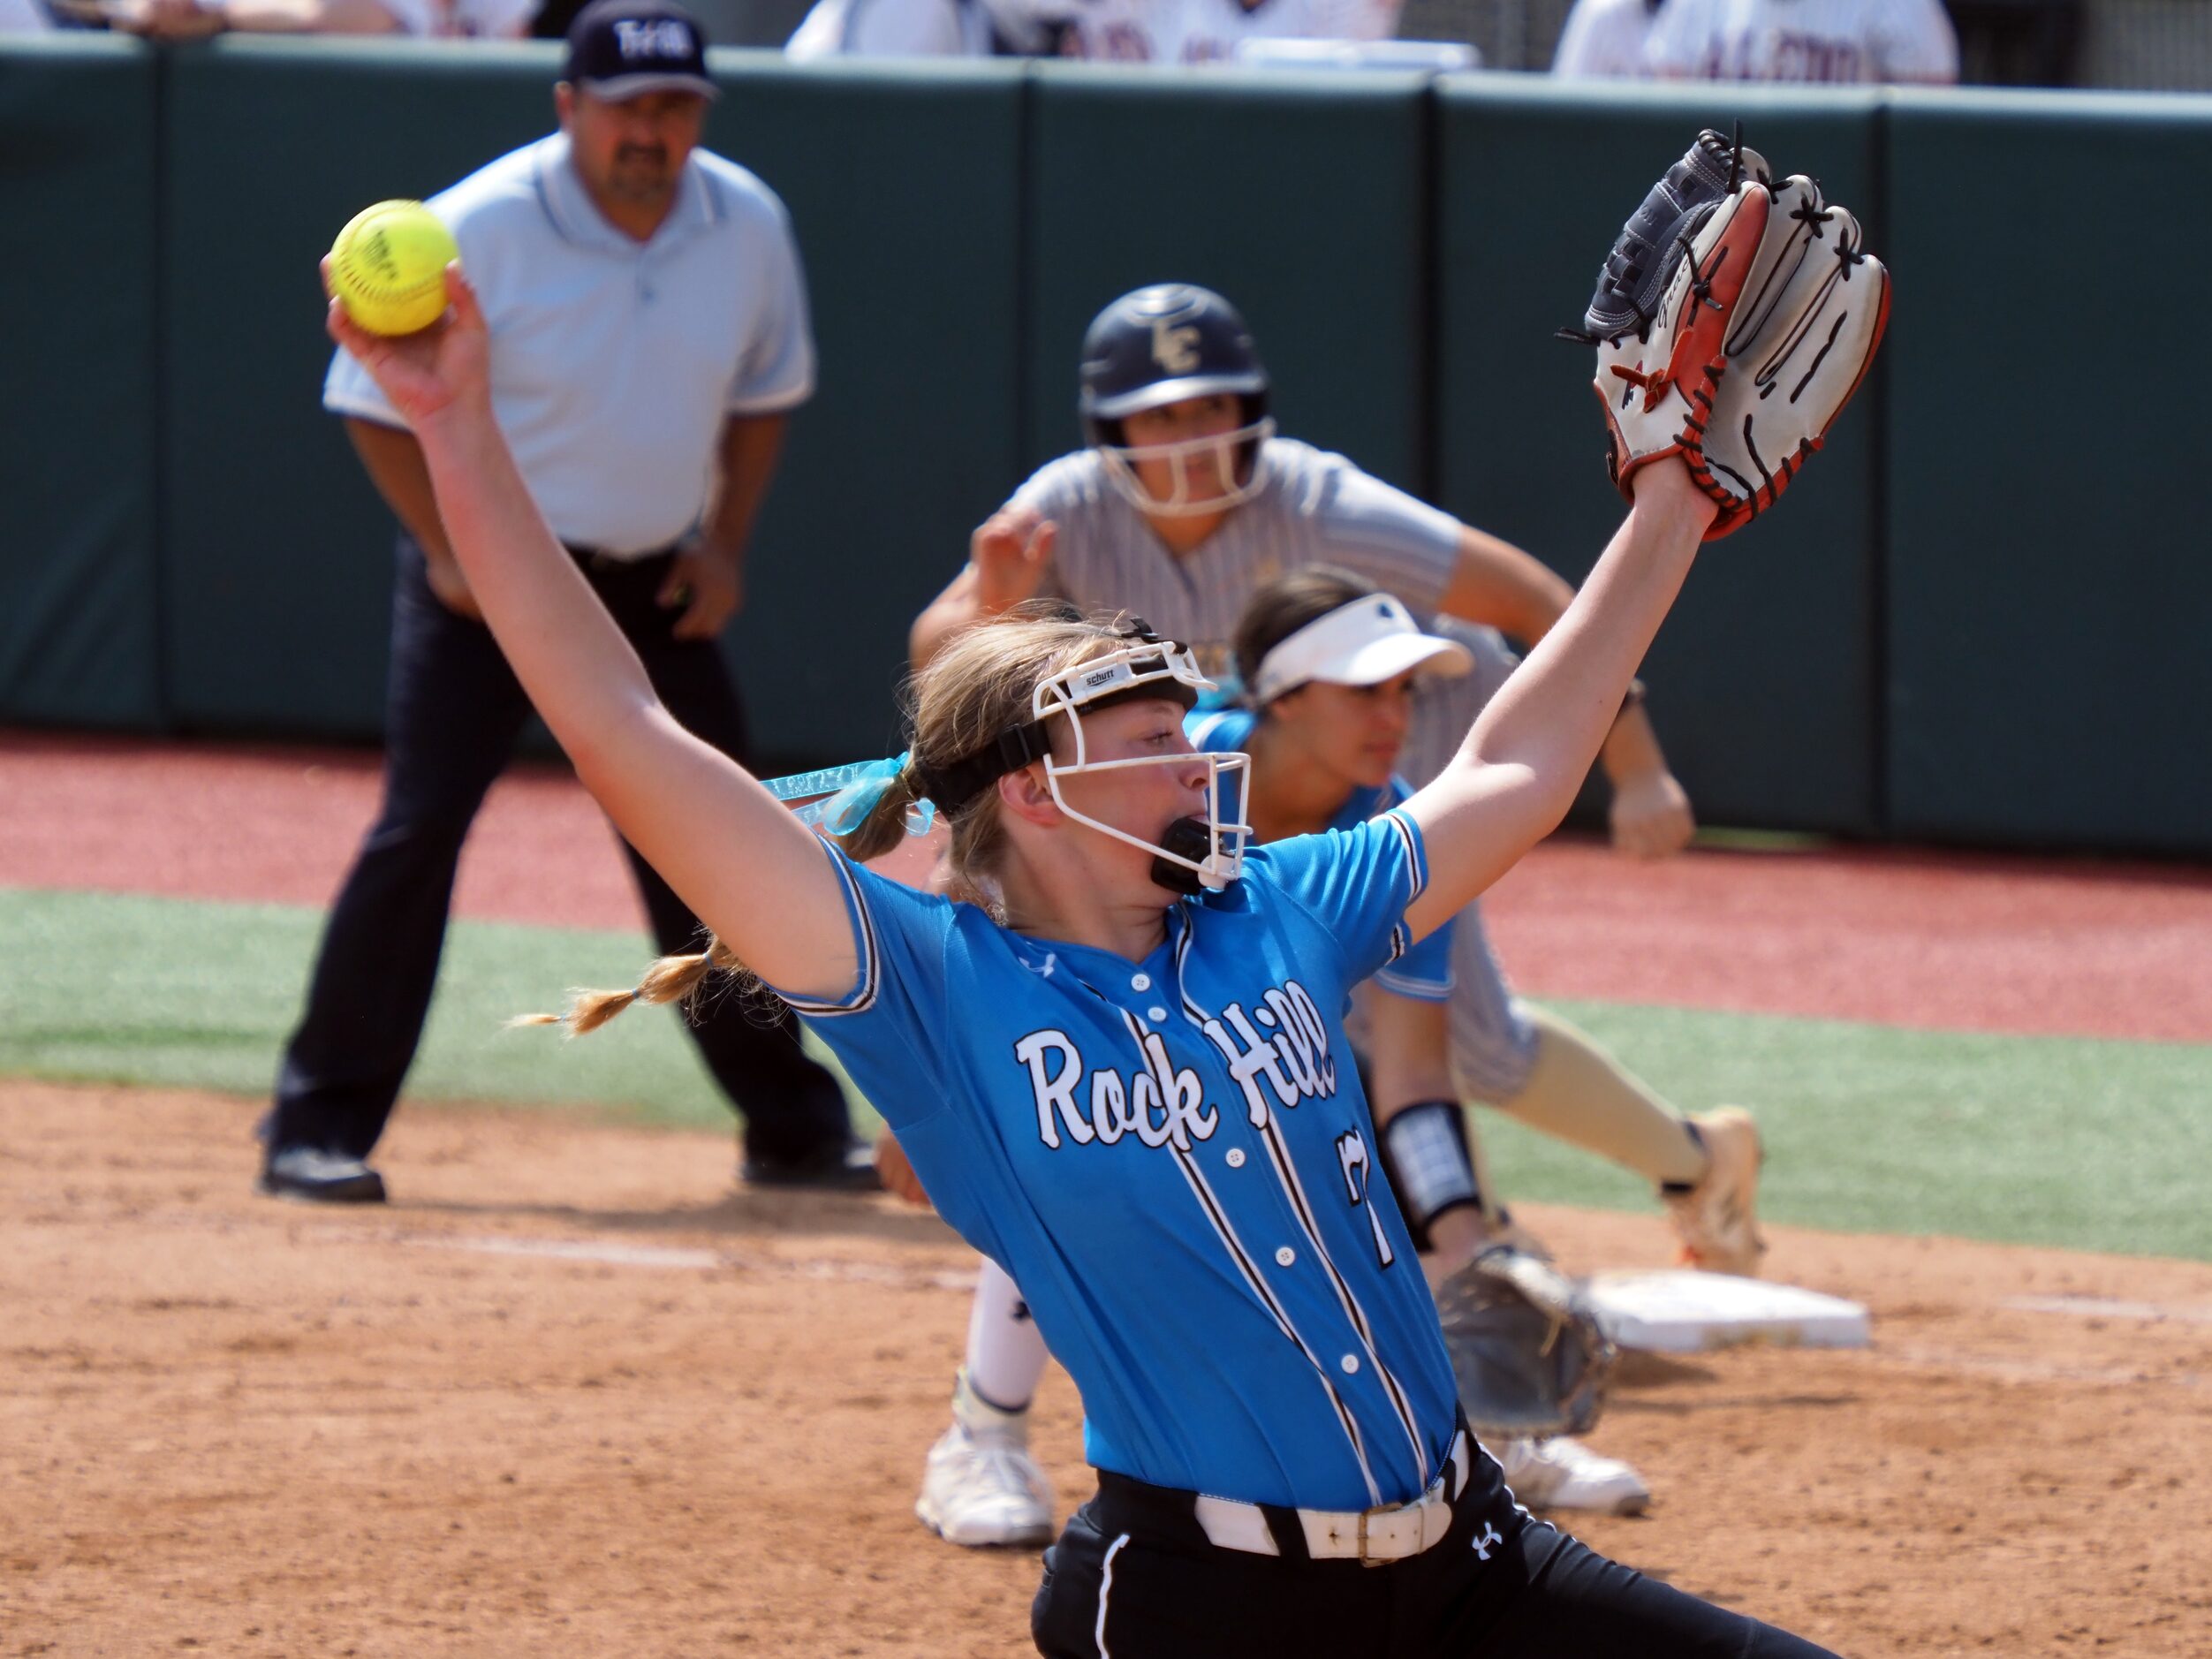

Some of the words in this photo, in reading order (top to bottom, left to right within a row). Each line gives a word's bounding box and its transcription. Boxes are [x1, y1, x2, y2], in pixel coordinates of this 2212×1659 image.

[1086, 670, 1114, 686] schutt
[1015, 1029, 1218, 1151] Rock
[1203, 980, 1336, 1130] Hill
[1336, 1125, 1395, 1269] 7
